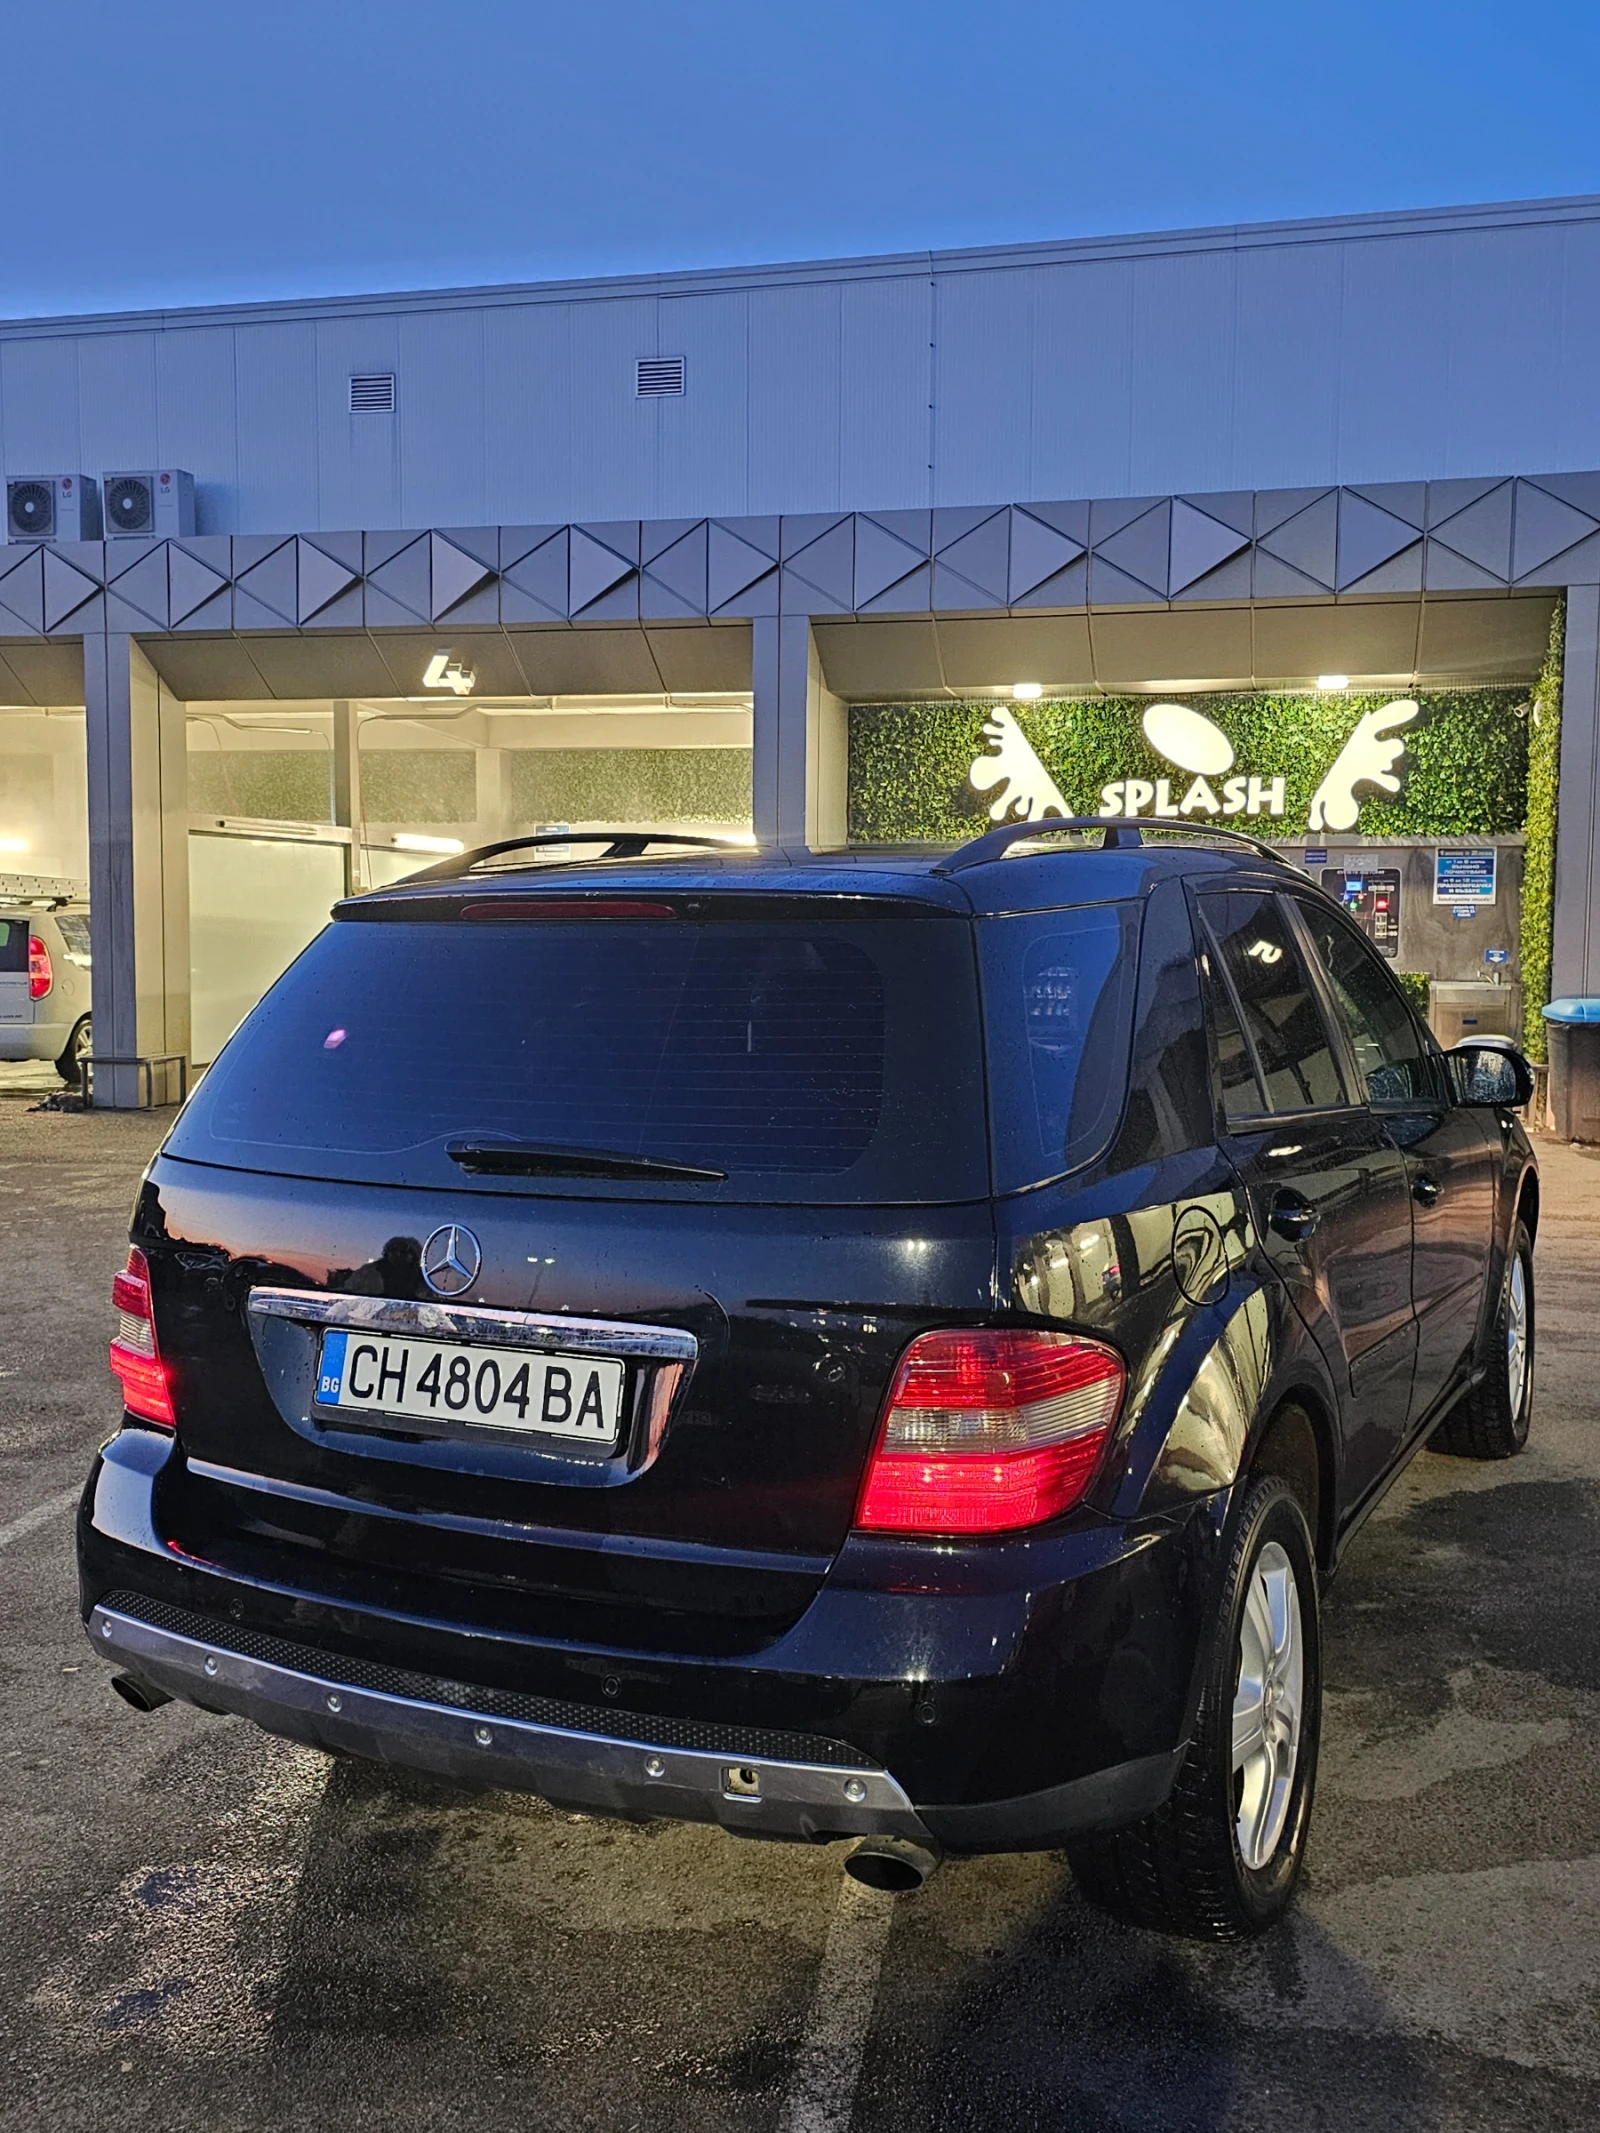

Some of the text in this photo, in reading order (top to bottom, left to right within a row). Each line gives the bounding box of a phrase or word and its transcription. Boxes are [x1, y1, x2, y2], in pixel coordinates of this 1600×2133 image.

[62, 491, 72, 499] LG
[161, 486, 170, 494] LG
[1099, 774, 1286, 818] SPLASH
[320, 1376, 340, 1394] BG
[349, 1344, 604, 1429] CH 4804 BA
